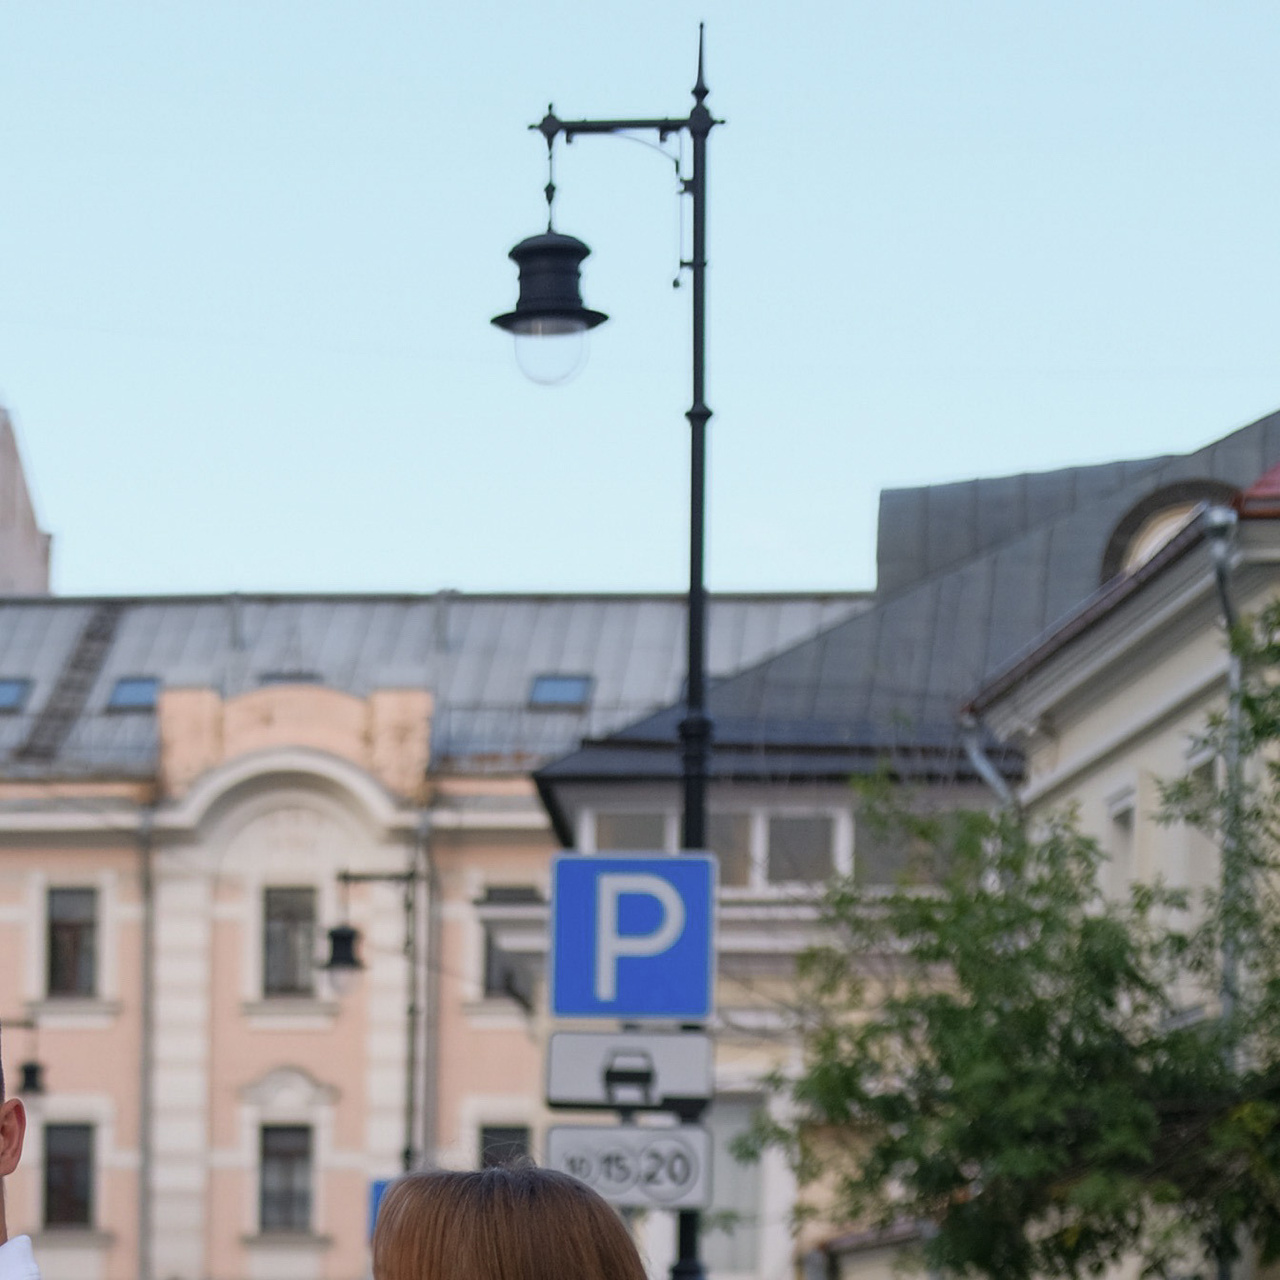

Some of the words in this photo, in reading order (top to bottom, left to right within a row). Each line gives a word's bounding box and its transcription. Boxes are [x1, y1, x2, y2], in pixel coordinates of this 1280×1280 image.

[595, 873, 686, 1001] P
[602, 1153, 631, 1183] 15
[643, 1151, 690, 1186] 20
